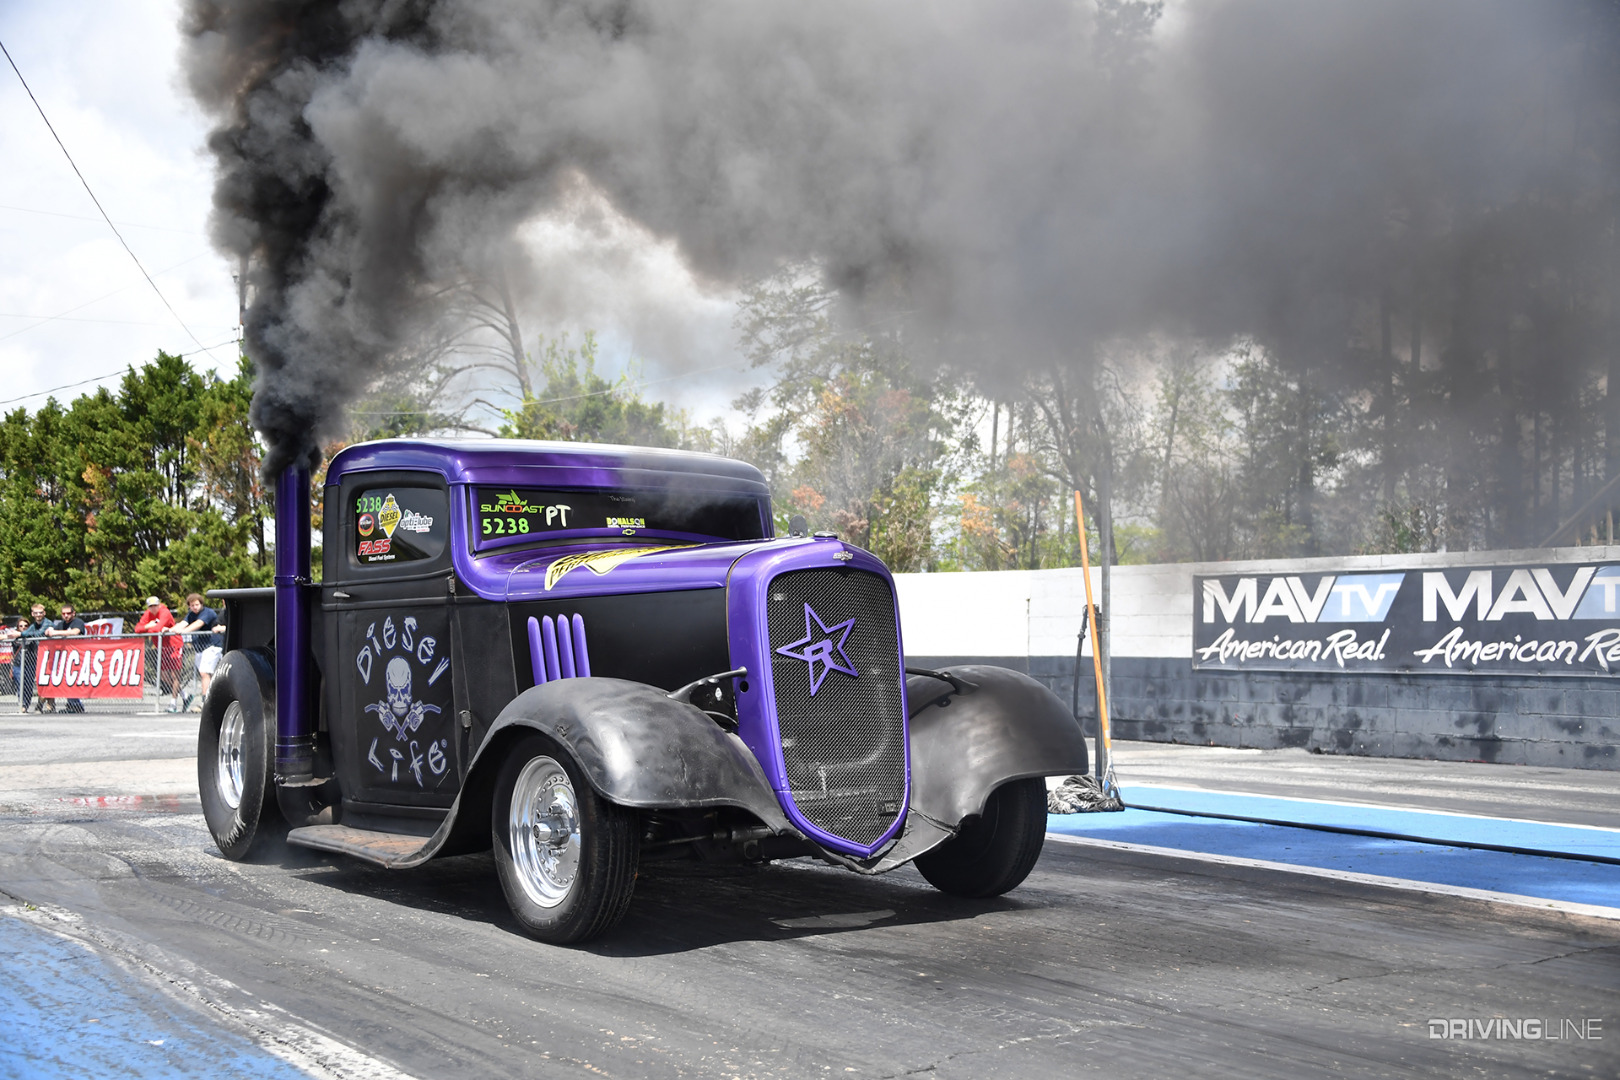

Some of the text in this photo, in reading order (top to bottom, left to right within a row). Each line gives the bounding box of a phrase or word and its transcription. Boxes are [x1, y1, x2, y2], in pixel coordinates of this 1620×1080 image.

[356, 496, 381, 513] 5238
[480, 504, 545, 513] SUNCOAST
[381, 511, 399, 523] DIESEL
[546, 504, 571, 527] PT
[606, 517, 645, 525] DONALSON
[482, 517, 530, 534] 5238
[358, 538, 392, 556] FASS
[1196, 628, 1390, 668] American Real.
[1414, 627, 1578, 668] American
[38, 649, 108, 687] LUCAS
[108, 648, 142, 687] OIL
